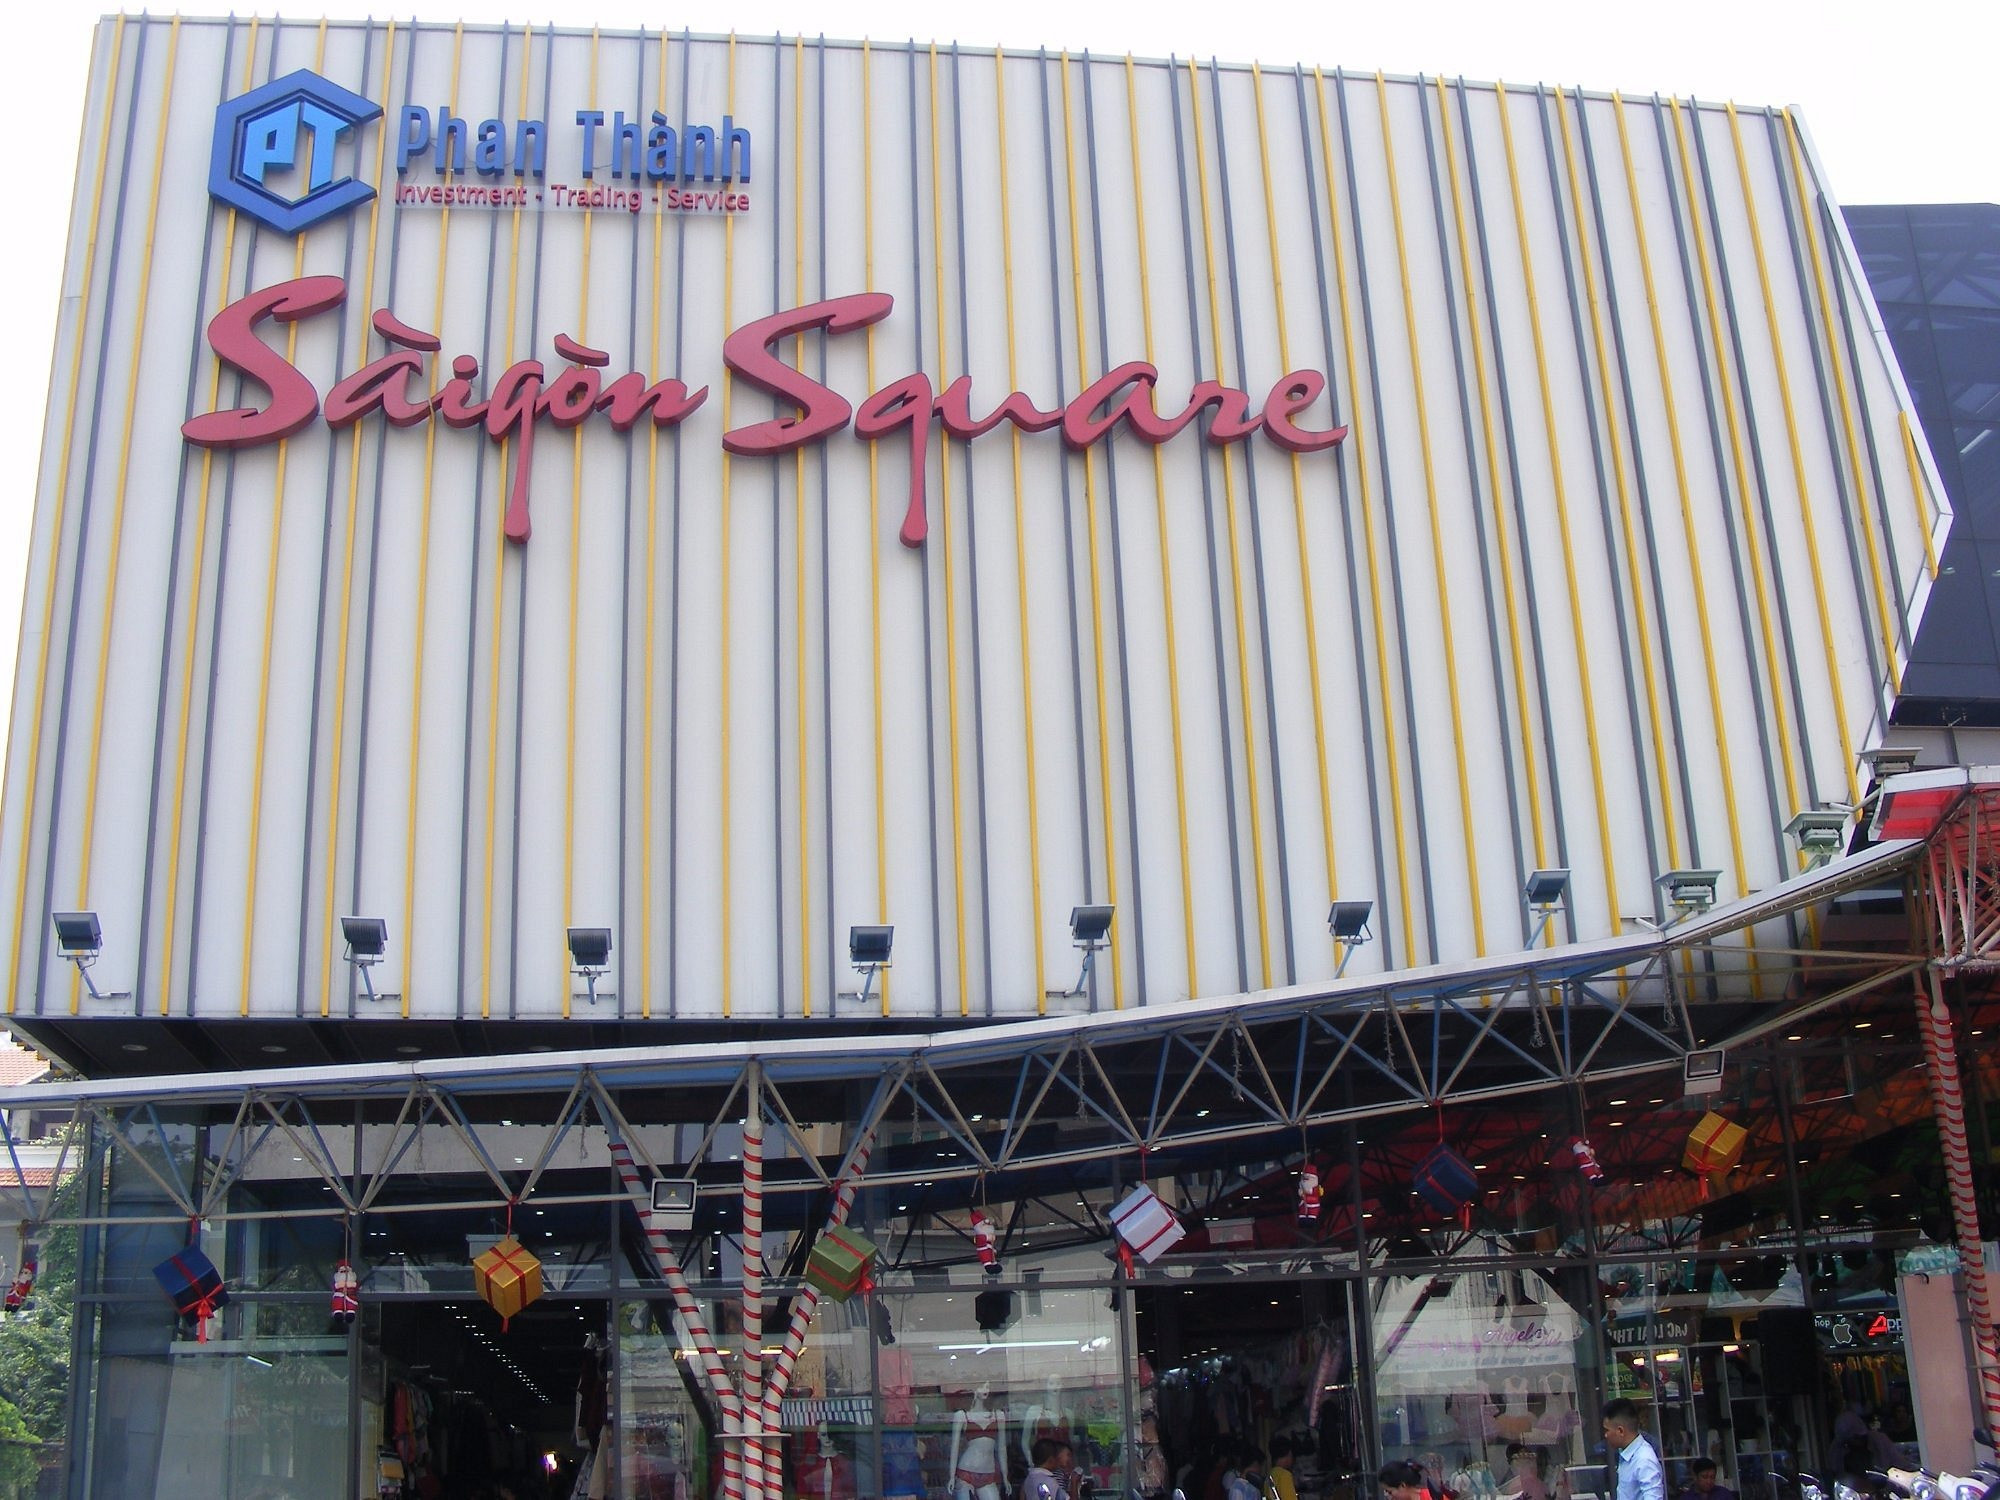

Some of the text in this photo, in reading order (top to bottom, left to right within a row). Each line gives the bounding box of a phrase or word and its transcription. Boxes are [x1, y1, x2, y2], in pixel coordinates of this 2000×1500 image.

[242, 100, 351, 192] PT
[396, 104, 752, 184] Phan Thành
[395, 182, 527, 206] Investment
[550, 184, 643, 213] Trading
[667, 187, 750, 212] Service
[182, 276, 1348, 548] Sàigòn Square
